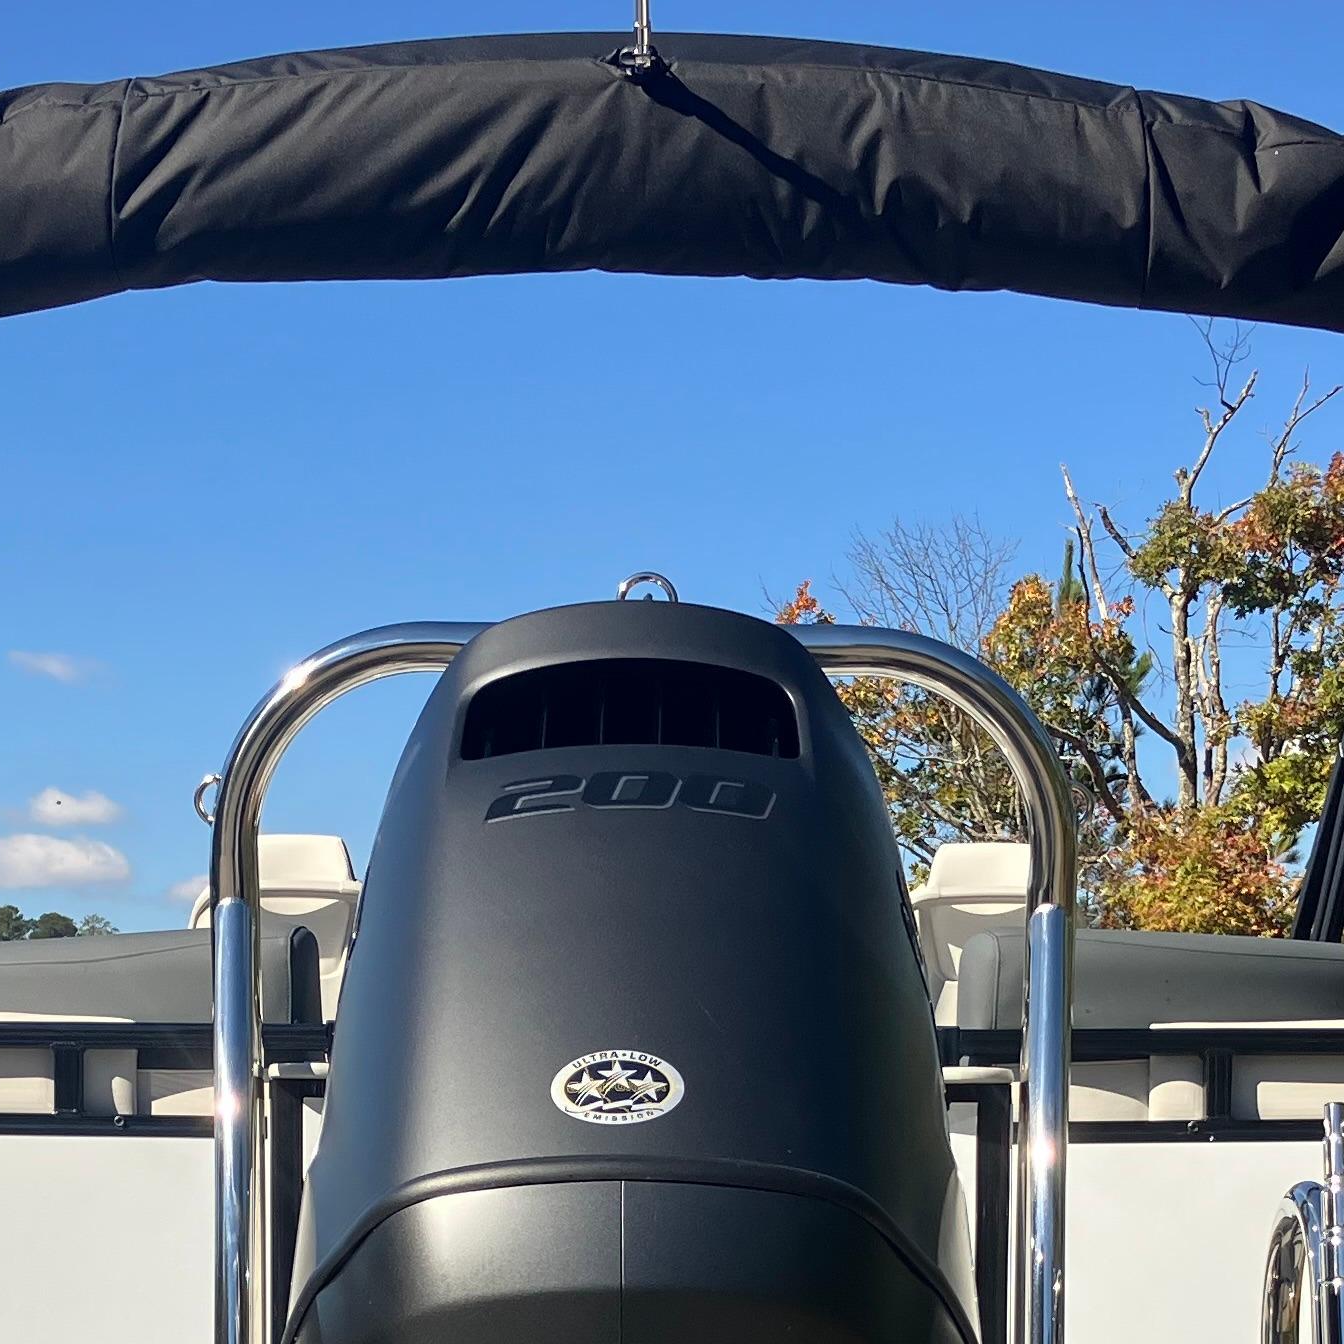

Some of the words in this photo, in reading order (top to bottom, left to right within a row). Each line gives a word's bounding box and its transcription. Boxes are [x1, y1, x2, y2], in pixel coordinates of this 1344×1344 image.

[484, 771, 777, 823] 200
[572, 1051, 619, 1069] ULTRA
[629, 1051, 662, 1068] LOW
[584, 1111, 654, 1122] EMISSION
